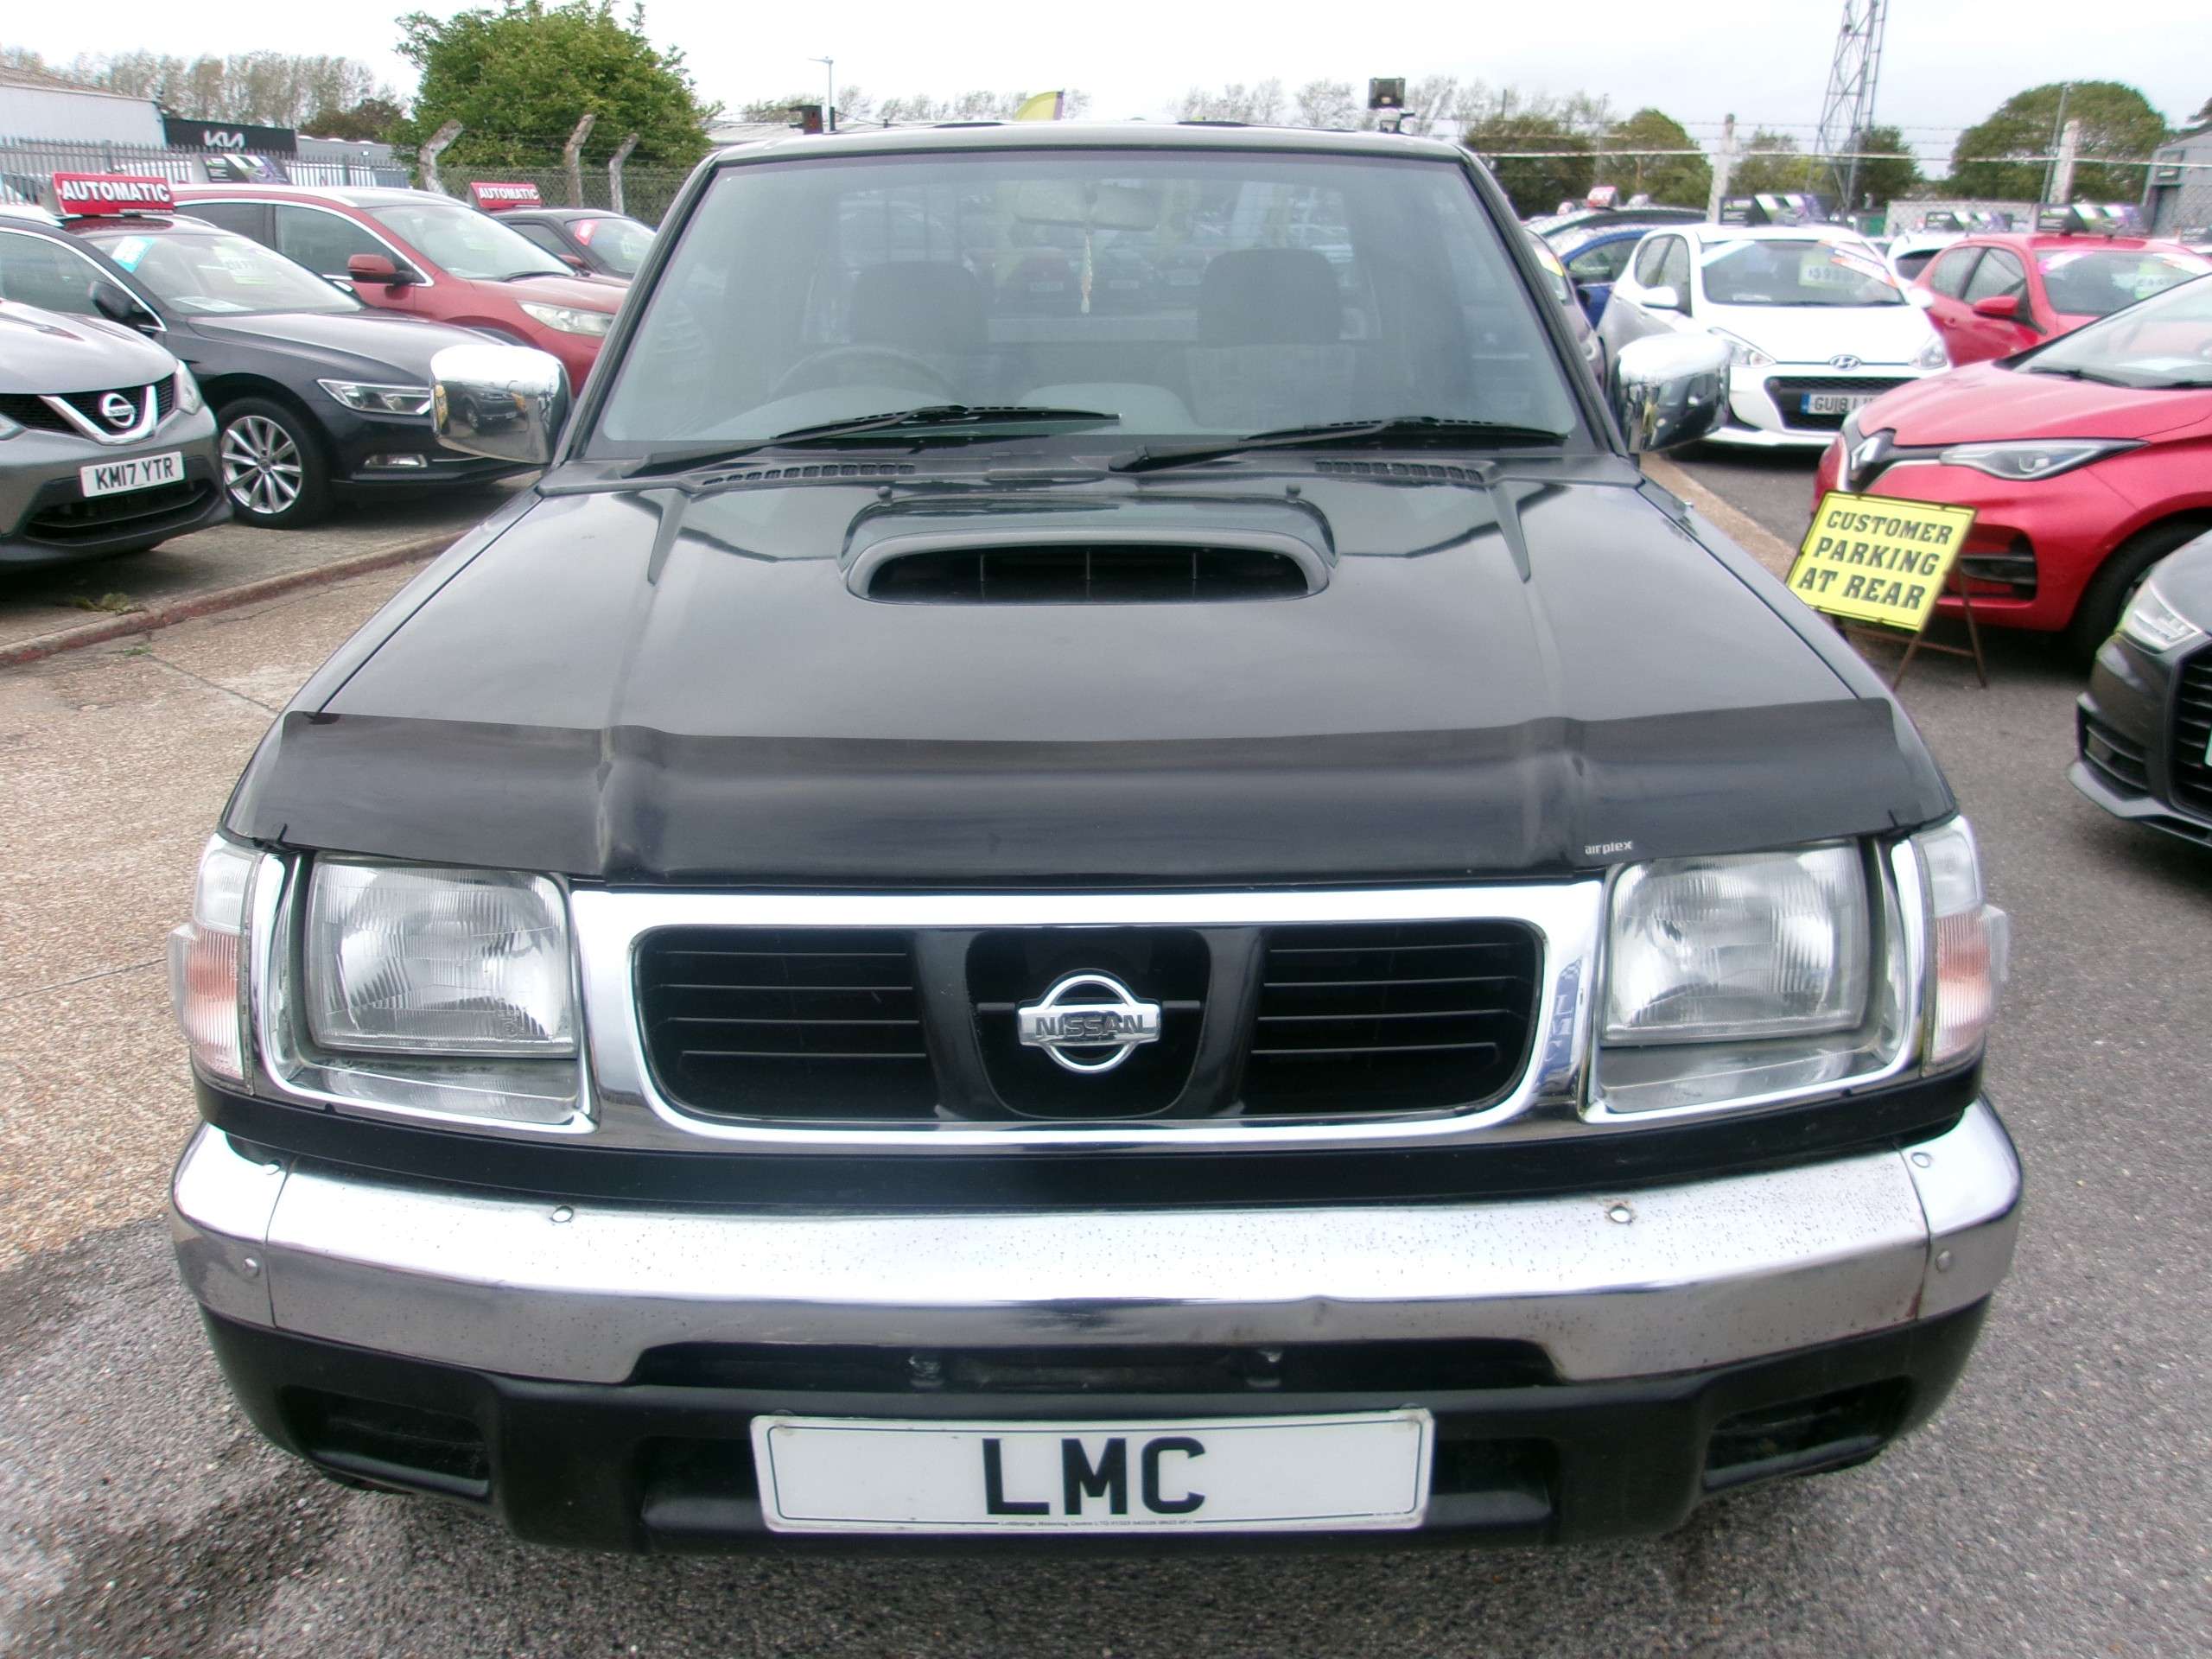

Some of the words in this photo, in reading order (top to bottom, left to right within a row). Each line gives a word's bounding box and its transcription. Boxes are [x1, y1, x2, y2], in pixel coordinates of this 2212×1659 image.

[62, 180, 171, 203] AUTOMATIC
[479, 188, 540, 200] AUTOMATIC
[95, 463, 137, 491] KM17
[142, 457, 175, 482] YTR
[1826, 510, 1954, 545] CUSTOMER
[1812, 537, 1941, 576] PARKING
[1796, 567, 1839, 593] AT
[1841, 575, 1926, 610] REAR
[1584, 841, 1632, 855] airplex
[1035, 1014, 1144, 1037] NISSAN
[982, 1437, 1206, 1516] LMC
